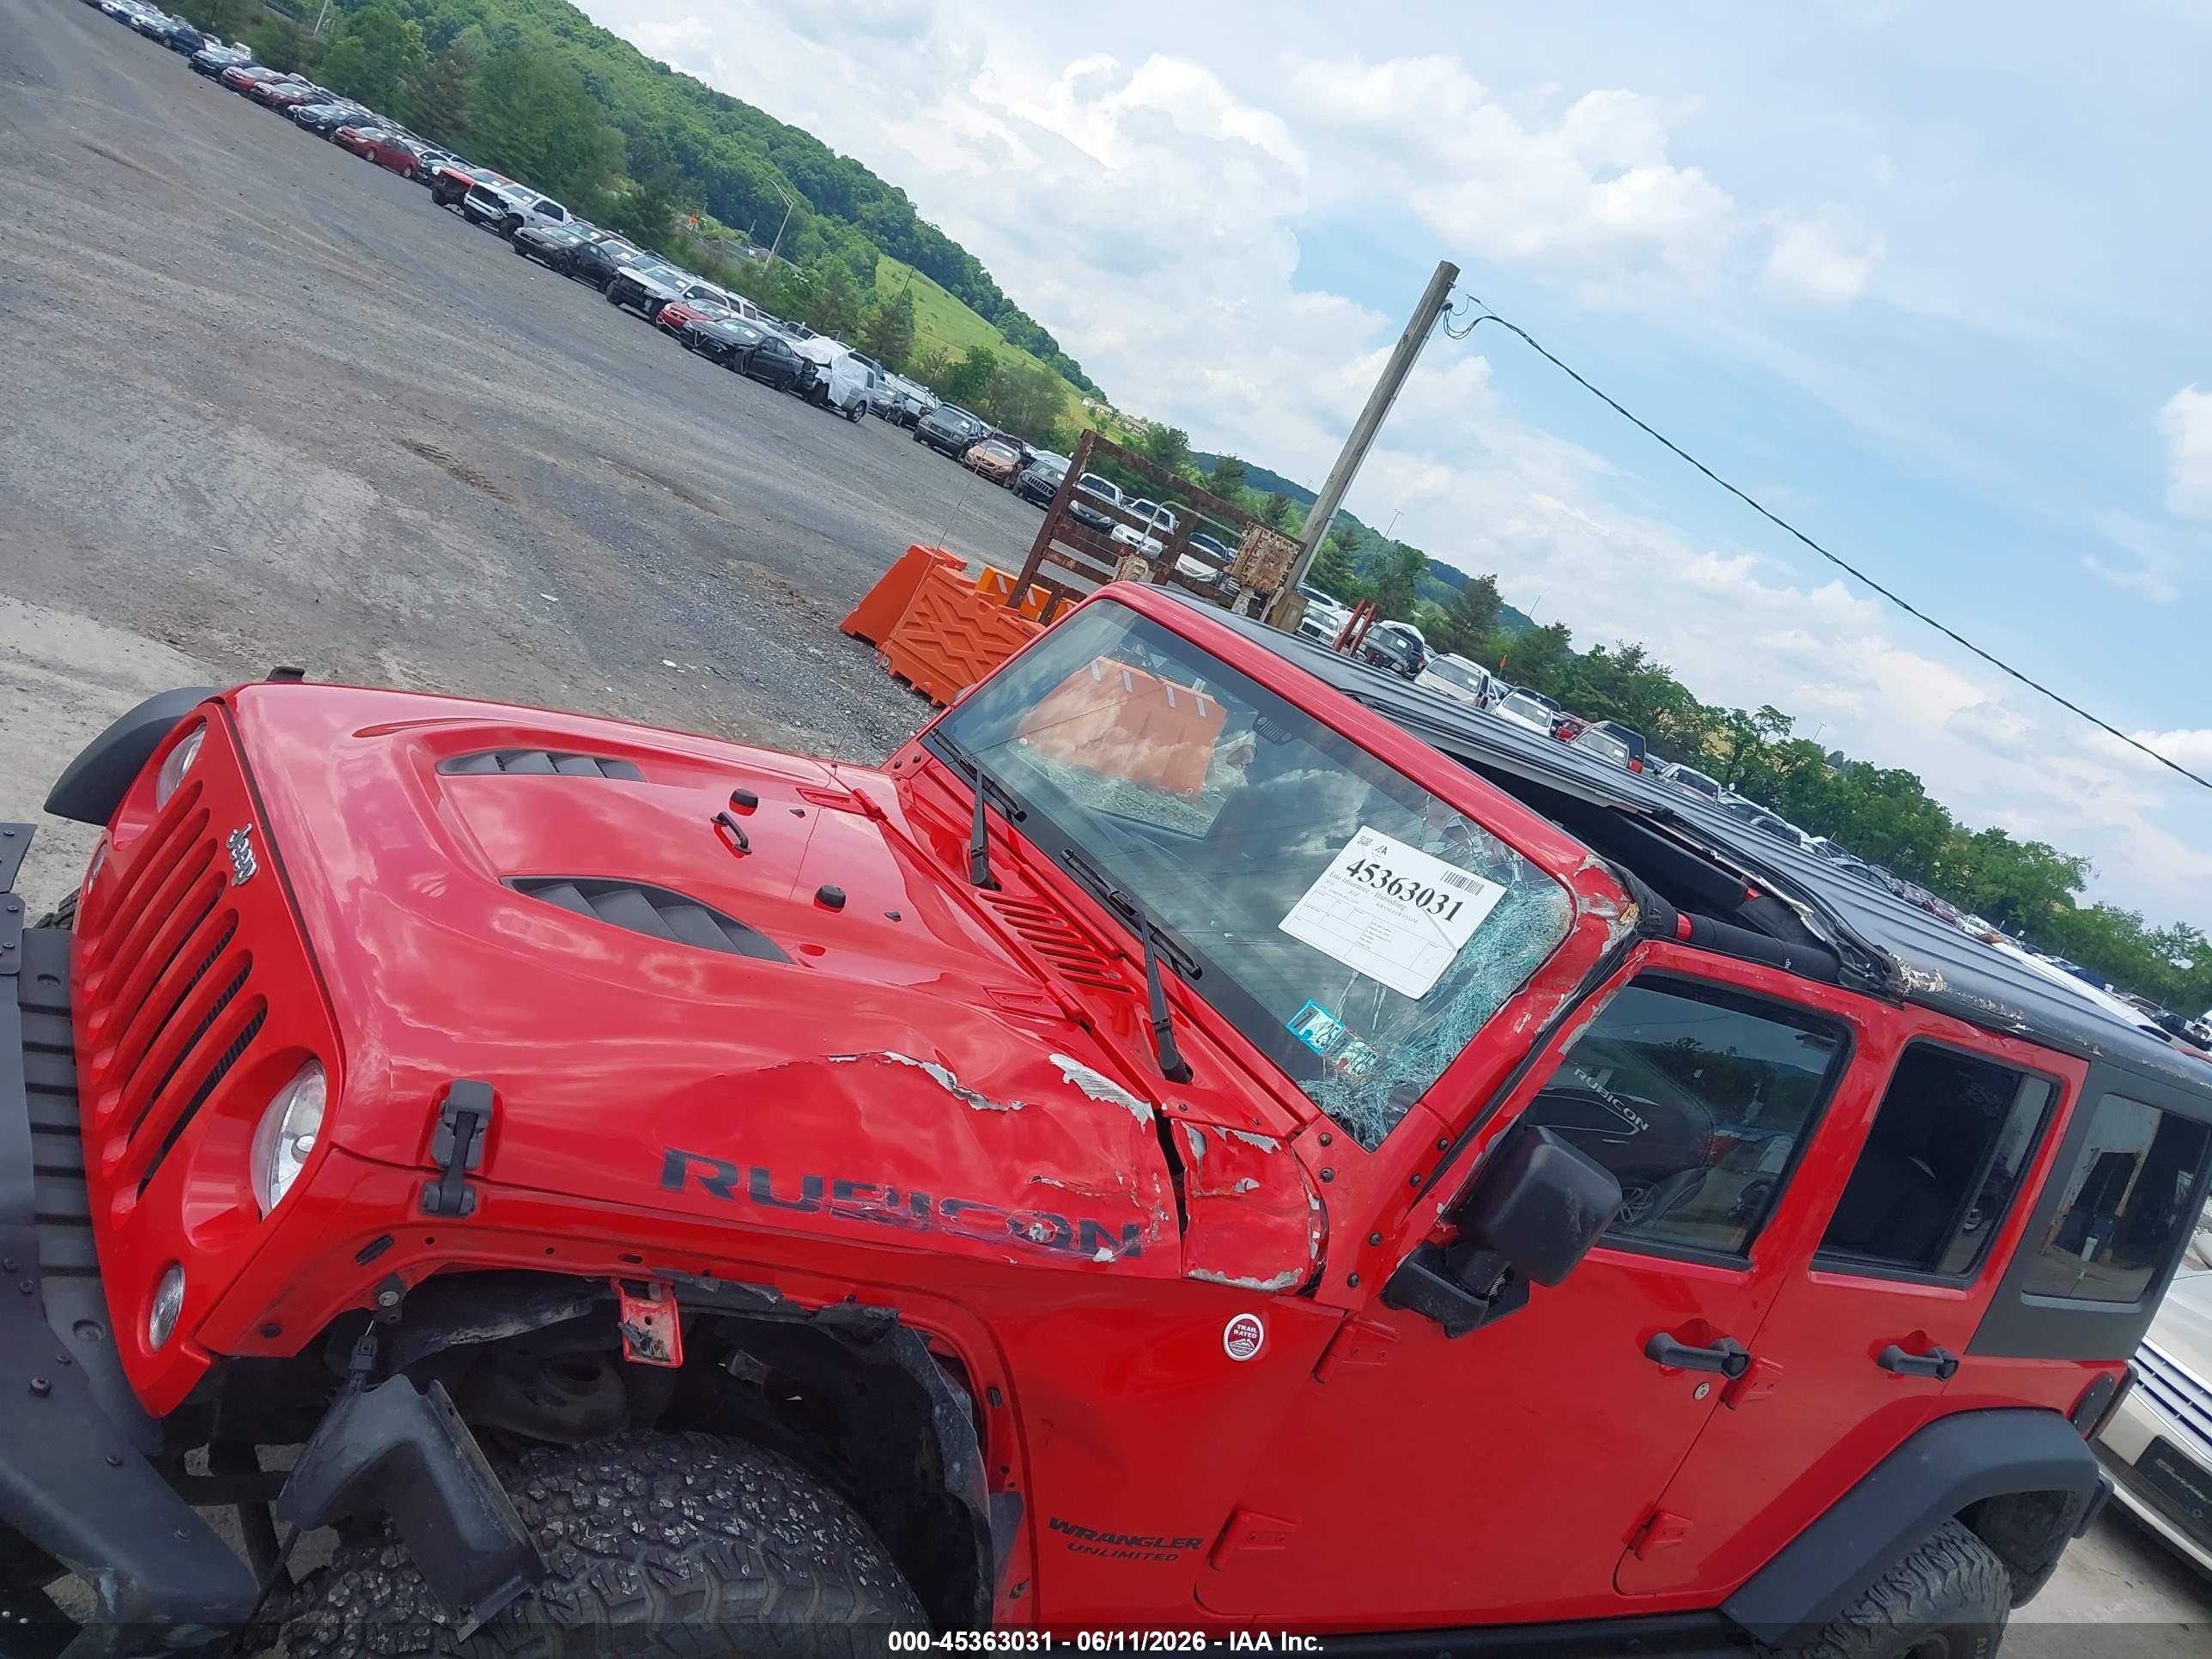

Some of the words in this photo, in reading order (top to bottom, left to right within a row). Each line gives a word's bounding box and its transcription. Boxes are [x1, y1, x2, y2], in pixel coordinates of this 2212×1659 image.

[1329, 871, 1342, 881] Erie
[1342, 876, 1370, 894] Insurance
[1374, 892, 1407, 911] Harrisburg
[1346, 859, 1464, 922] 45363031
[1574, 1068, 1650, 1132] RUBICON
[661, 1147, 1141, 1259] RUBICON
[1233, 1329, 1258, 1339] RATED
[1237, 1324, 1258, 1334] TRAIL
[1048, 1516, 1204, 1551] WRANGLER
[1067, 1542, 1179, 1562] UNLIMITED
